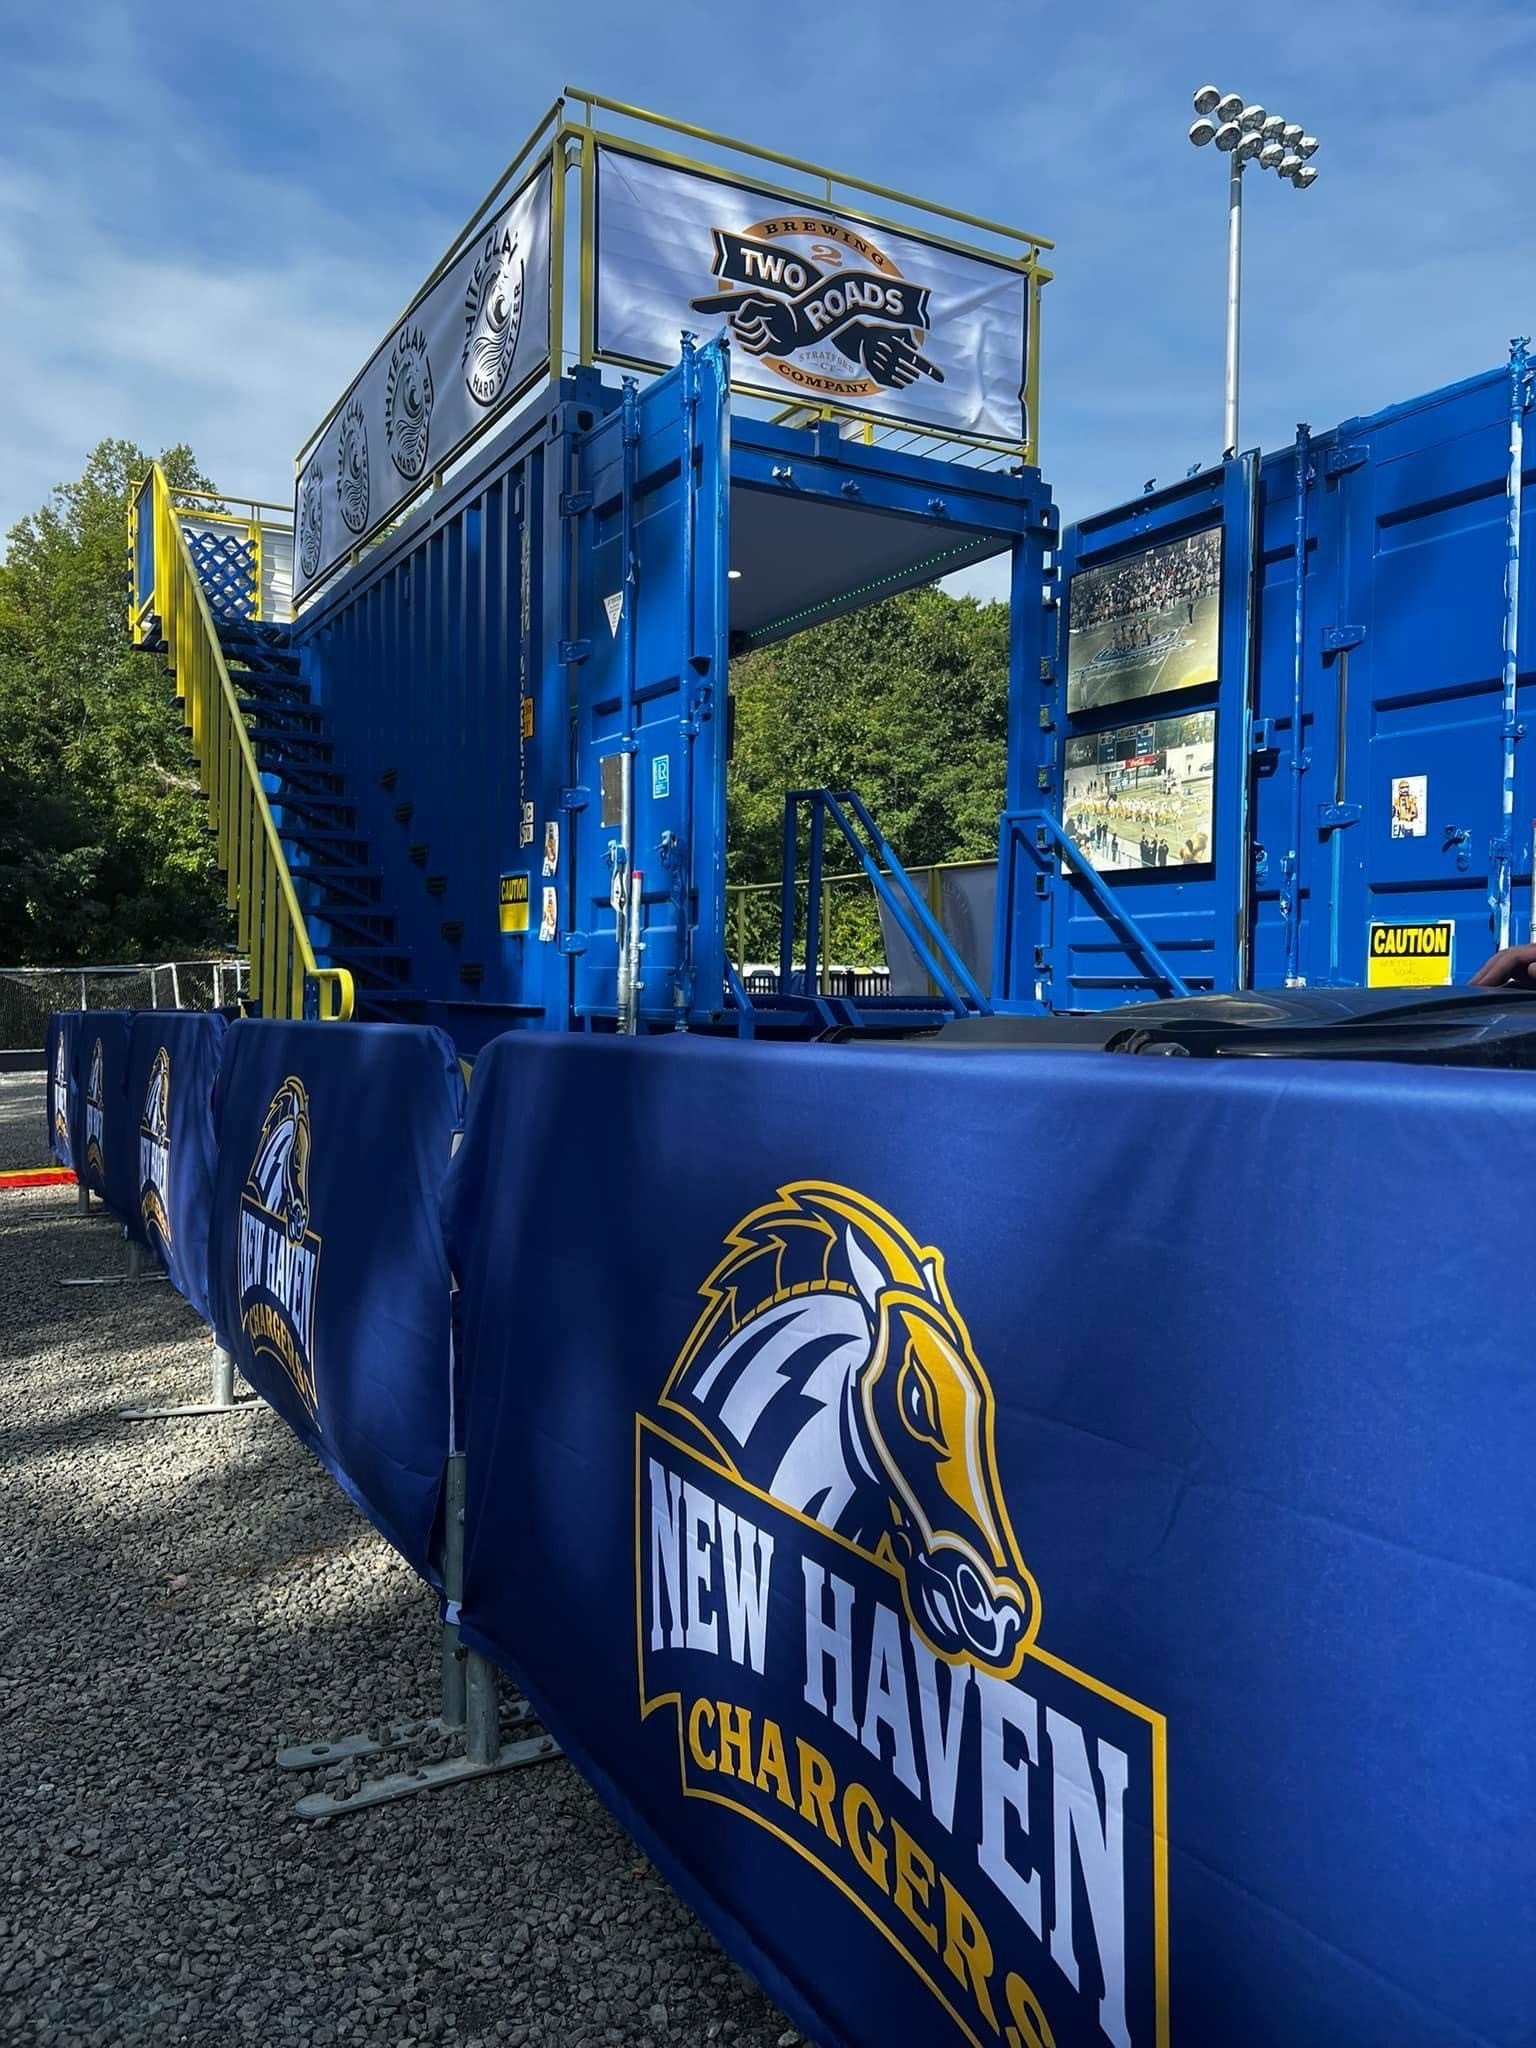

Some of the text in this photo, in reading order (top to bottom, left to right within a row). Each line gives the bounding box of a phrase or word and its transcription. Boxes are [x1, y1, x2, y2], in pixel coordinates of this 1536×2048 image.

[763, 220, 885, 267] BREWING
[810, 244, 842, 267] 2
[740, 247, 808, 292] TWO
[461, 257, 482, 369] WHITE
[803, 280, 904, 332] ROADS
[399, 325, 428, 361] CLAW
[472, 281, 522, 398] HARD SELTZER
[778, 363, 869, 393] COMPANY
[501, 877, 528, 902] CAUTION
[1373, 927, 1448, 955] CAUTION
[240, 1209, 317, 1364] NEW HAVEN
[649, 1456, 1132, 2048] NEW HAVEN
[688, 1697, 1057, 2048] CHARGERS
